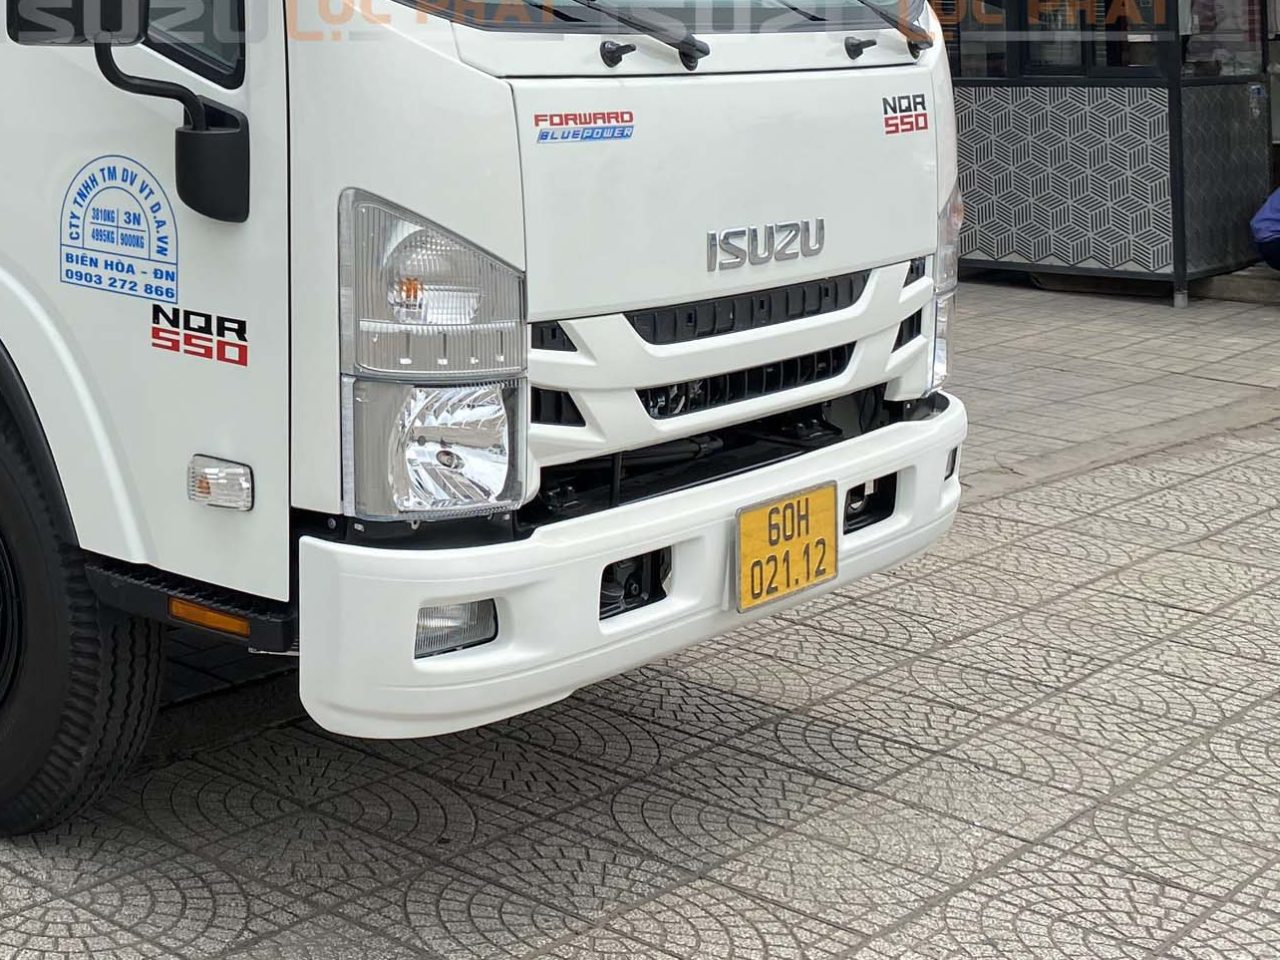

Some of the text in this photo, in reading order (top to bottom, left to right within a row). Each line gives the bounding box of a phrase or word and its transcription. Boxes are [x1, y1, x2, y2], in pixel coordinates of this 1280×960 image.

[534, 111, 634, 127] FORWARD
[882, 94, 926, 115] NQR
[884, 113, 928, 134] 550
[99, 166, 117, 183] TM
[121, 167, 138, 186] DV
[73, 173, 99, 208] TNHH
[139, 180, 155, 200] VT
[69, 211, 80, 240] CTY
[123, 211, 141, 226] 3N
[707, 218, 825, 272] ISUZU
[65, 251, 99, 268] BIÊN
[104, 257, 136, 276] HÒA
[153, 268, 176, 282] ĐN
[65, 269, 175, 299] 0903 272 866
[152, 303, 248, 342] NQR
[152, 326, 248, 367] 550
[768, 497, 809, 546] 60H
[751, 538, 826, 599] 021.12
